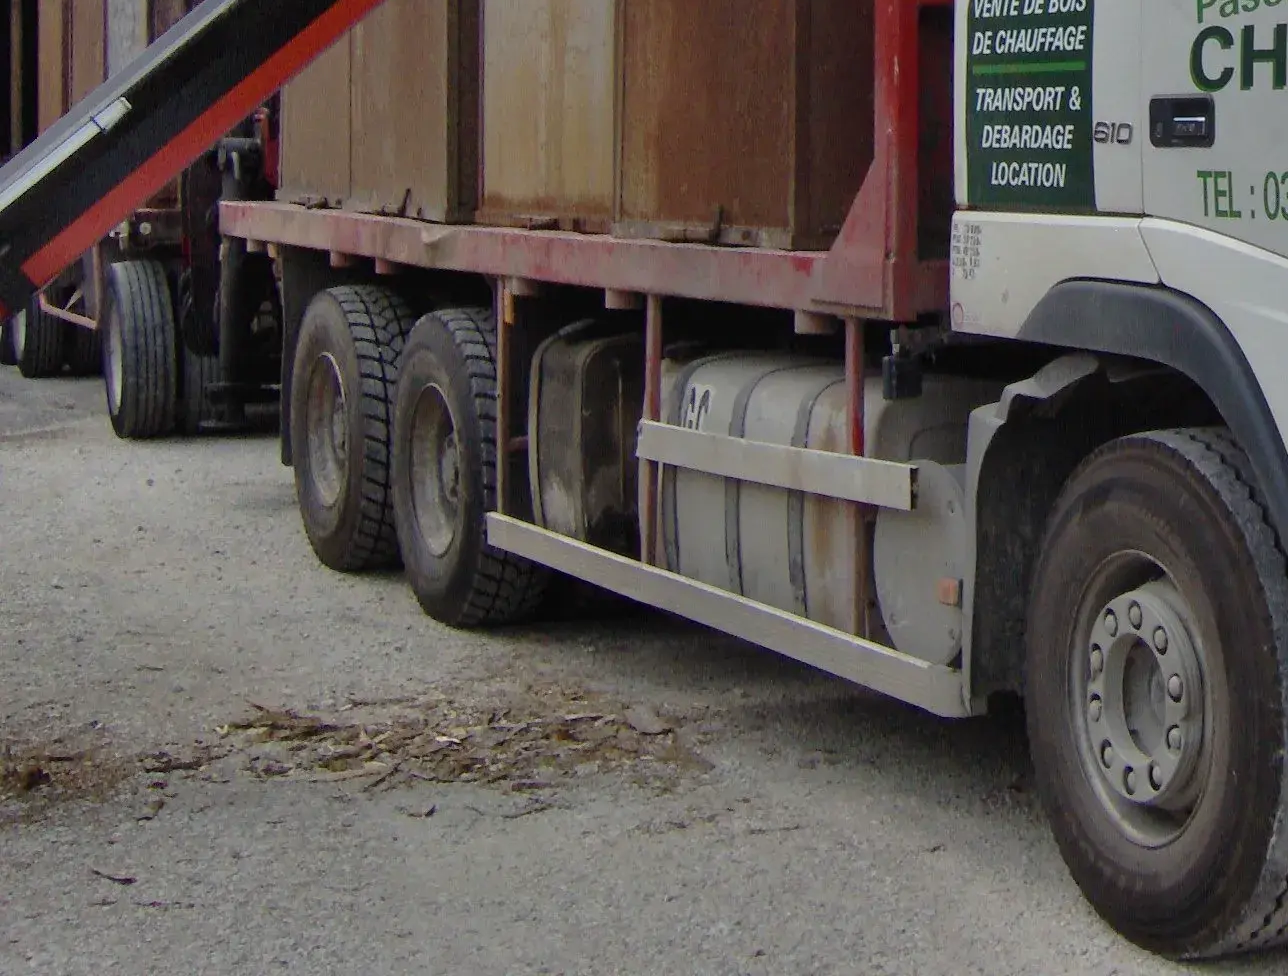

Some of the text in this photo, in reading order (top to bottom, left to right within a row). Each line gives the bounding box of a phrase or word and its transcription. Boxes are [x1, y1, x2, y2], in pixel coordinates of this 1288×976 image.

[972, 25, 1087, 55] DE CHAUFFAGE
[976, 86, 1081, 111] TRANSPORT &
[981, 124, 1075, 150] DEBARDAGE
[1094, 120, 1133, 146] 610
[991, 161, 1067, 188] LOCATION
